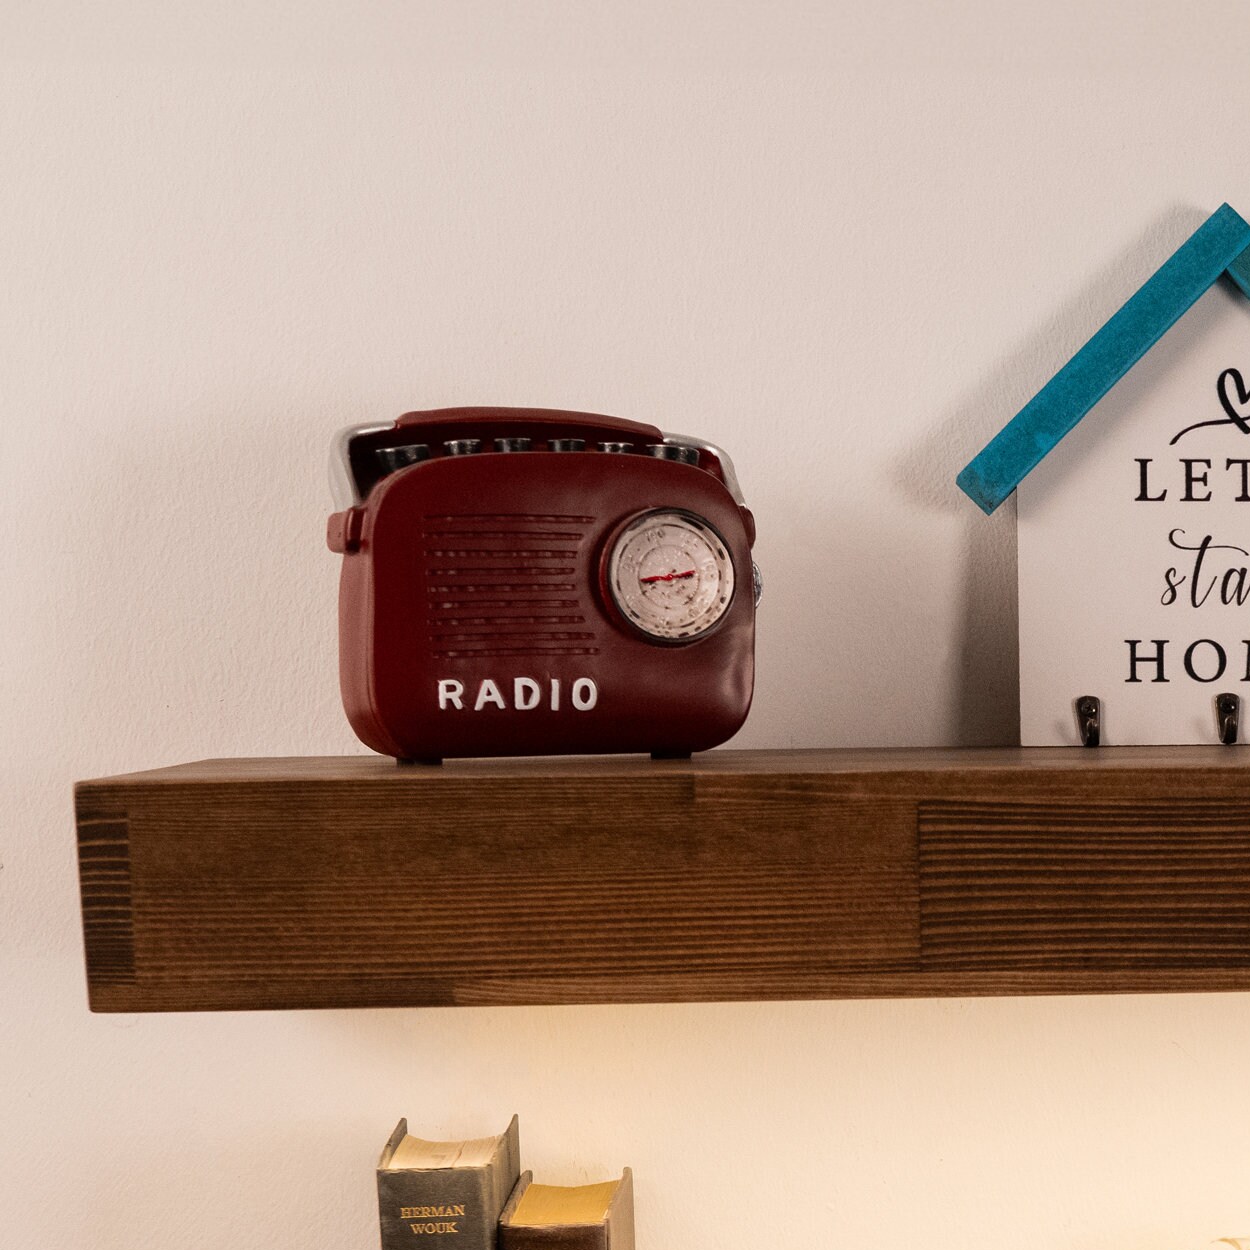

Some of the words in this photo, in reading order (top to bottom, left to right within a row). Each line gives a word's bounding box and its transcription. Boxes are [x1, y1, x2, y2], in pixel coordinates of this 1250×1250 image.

[438, 676, 599, 712] RADIO
[400, 1205, 465, 1219] HERMAN
[410, 1222, 458, 1234] WOUK
